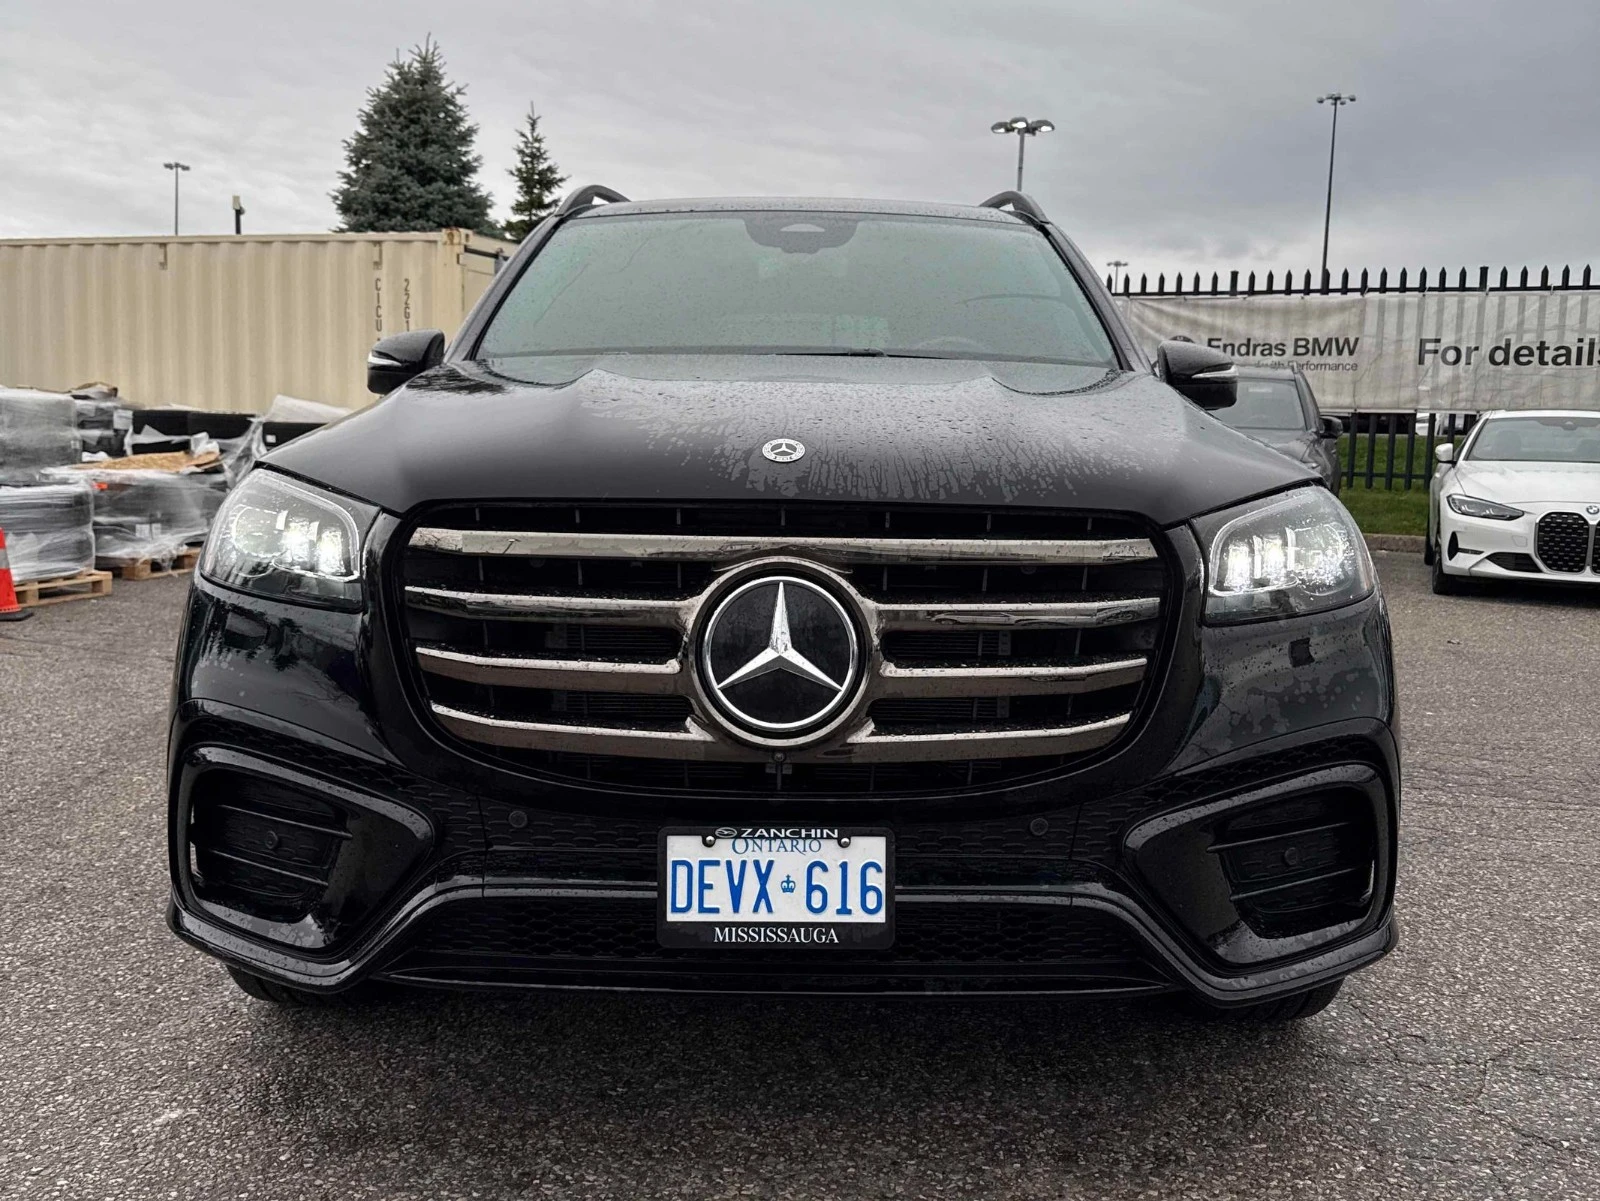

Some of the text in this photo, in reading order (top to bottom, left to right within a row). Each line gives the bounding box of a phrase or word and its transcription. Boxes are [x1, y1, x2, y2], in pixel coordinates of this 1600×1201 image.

[1207, 337, 1360, 357] Endras BMW
[1418, 337, 1600, 367] For detail
[741, 828, 839, 839] ZANCHIN
[731, 839, 822, 855] ONTARIO
[670, 859, 883, 915] DEVX 616
[714, 927, 840, 944] MISSISSAUGA
